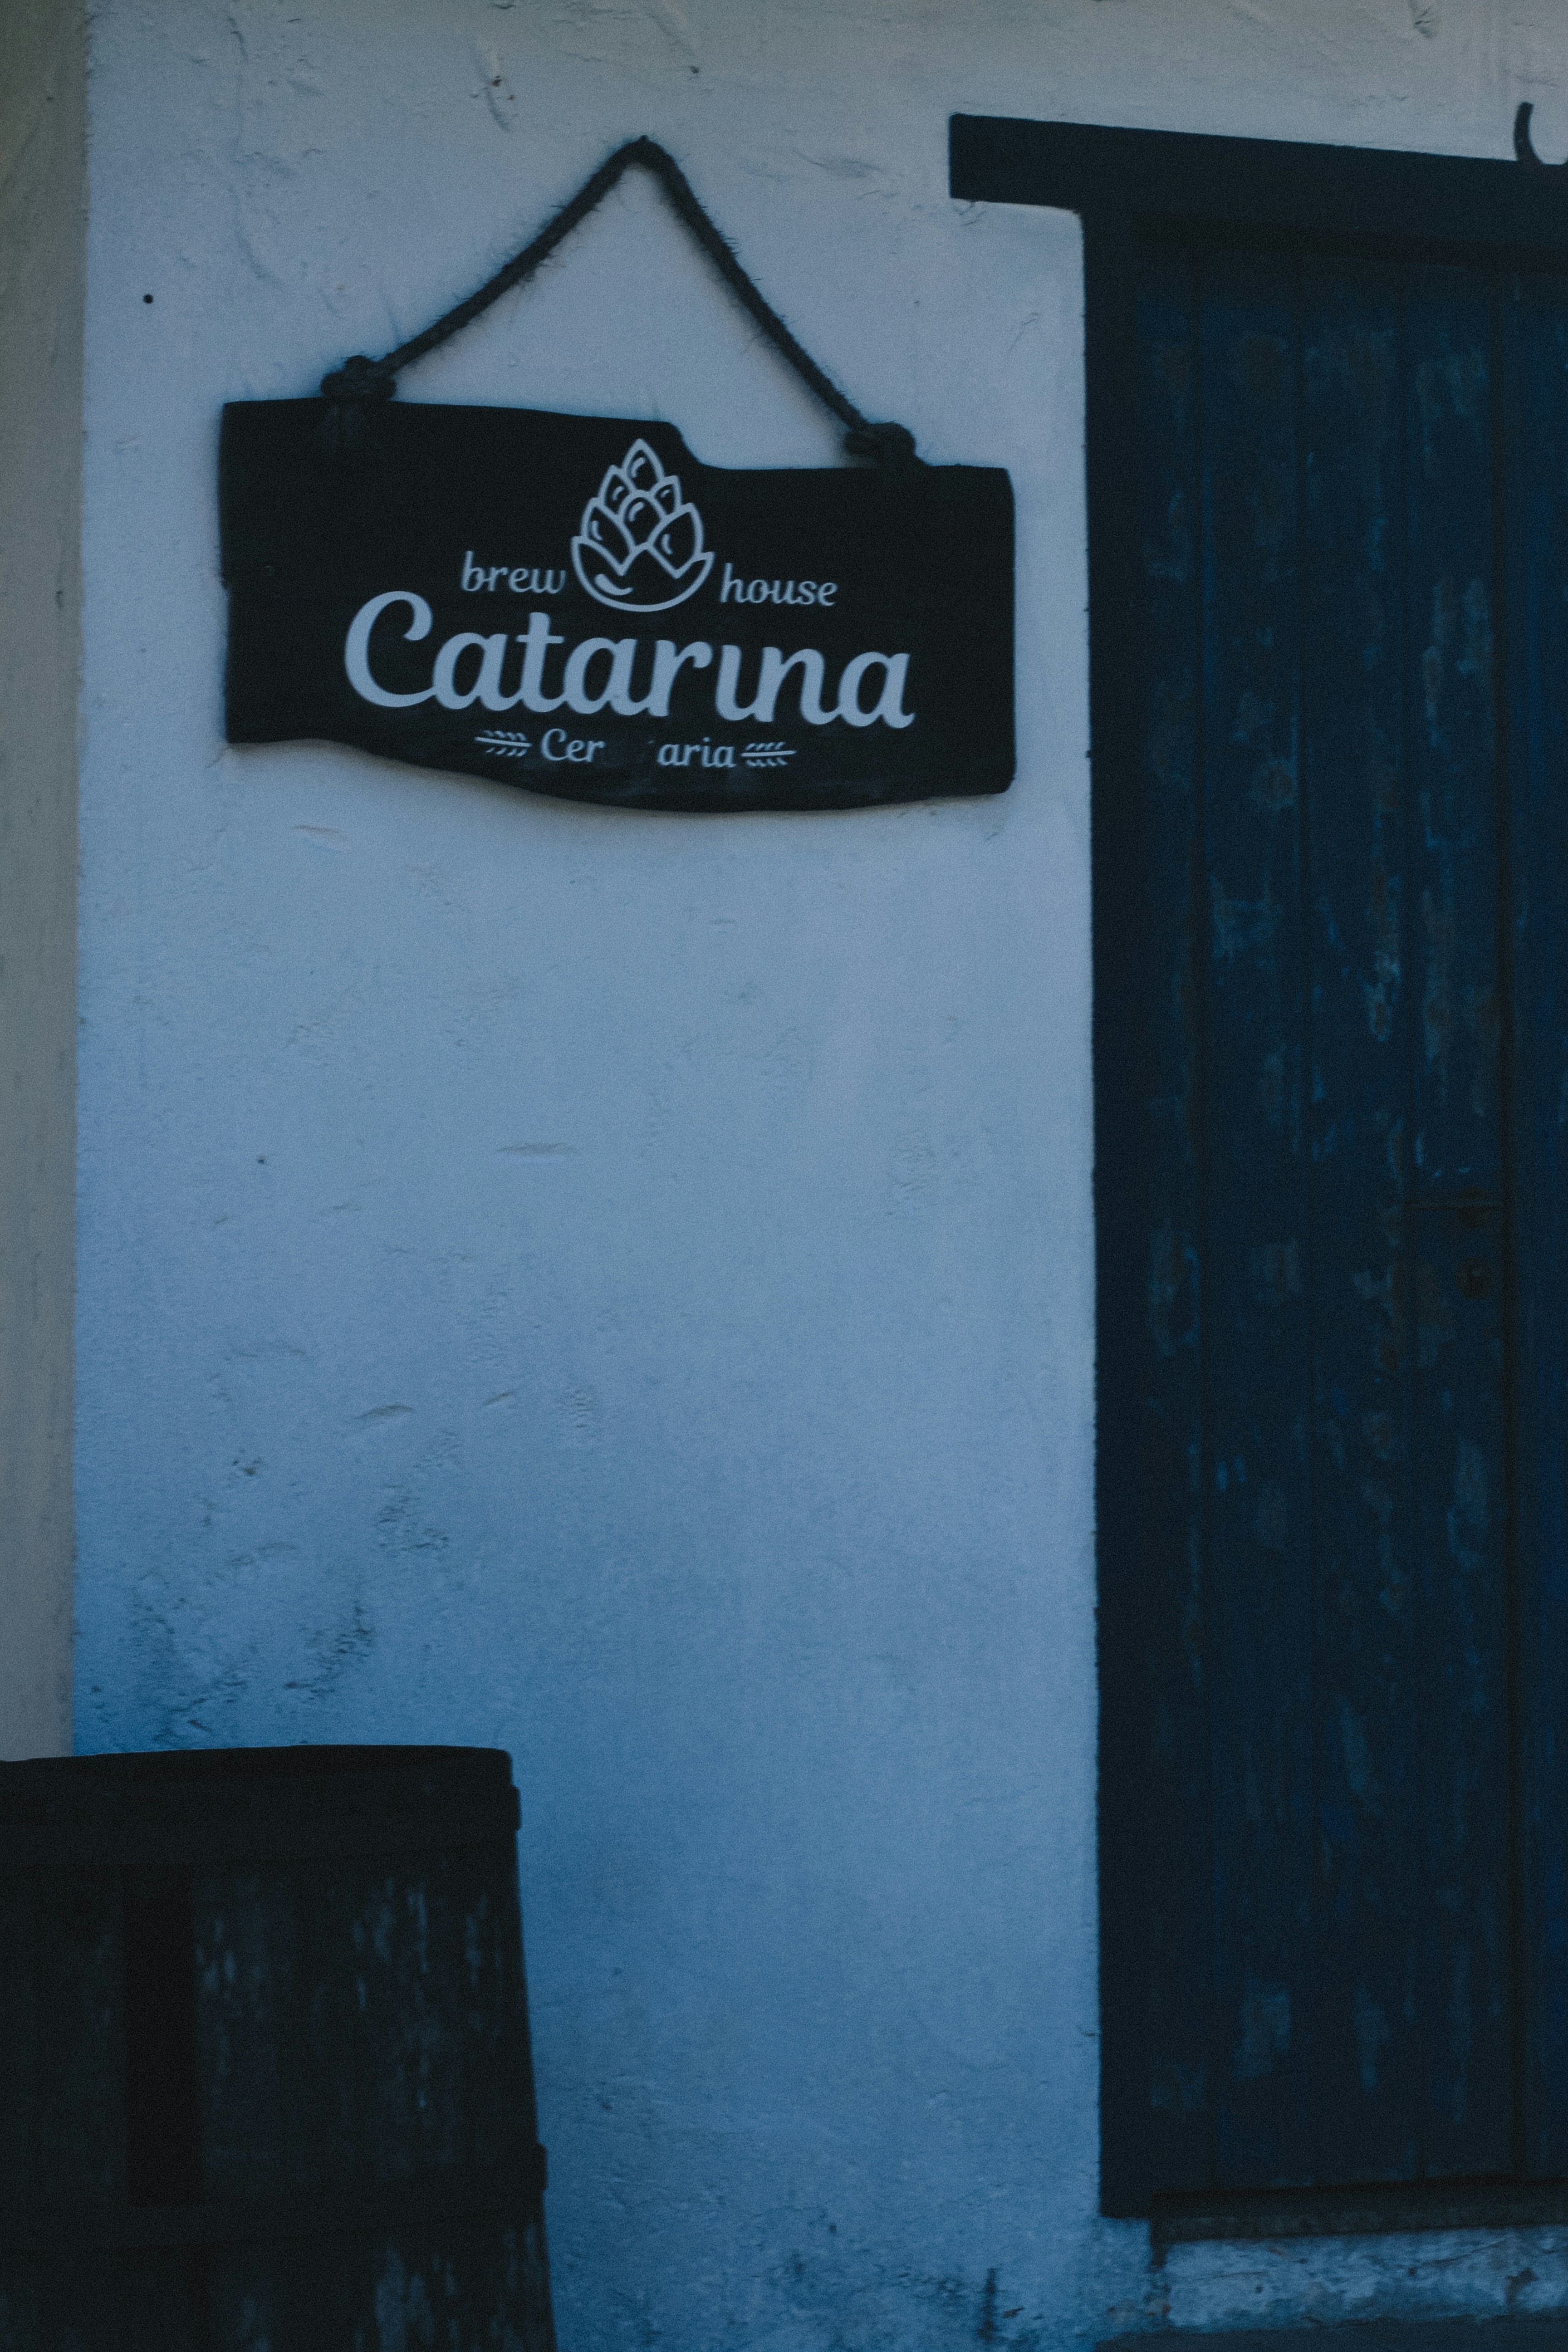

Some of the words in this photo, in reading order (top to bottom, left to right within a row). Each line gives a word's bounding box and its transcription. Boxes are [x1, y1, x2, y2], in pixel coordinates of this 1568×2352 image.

[460, 549, 567, 595] brew
[720, 562, 838, 607] house
[344, 590, 916, 730] Catarina
